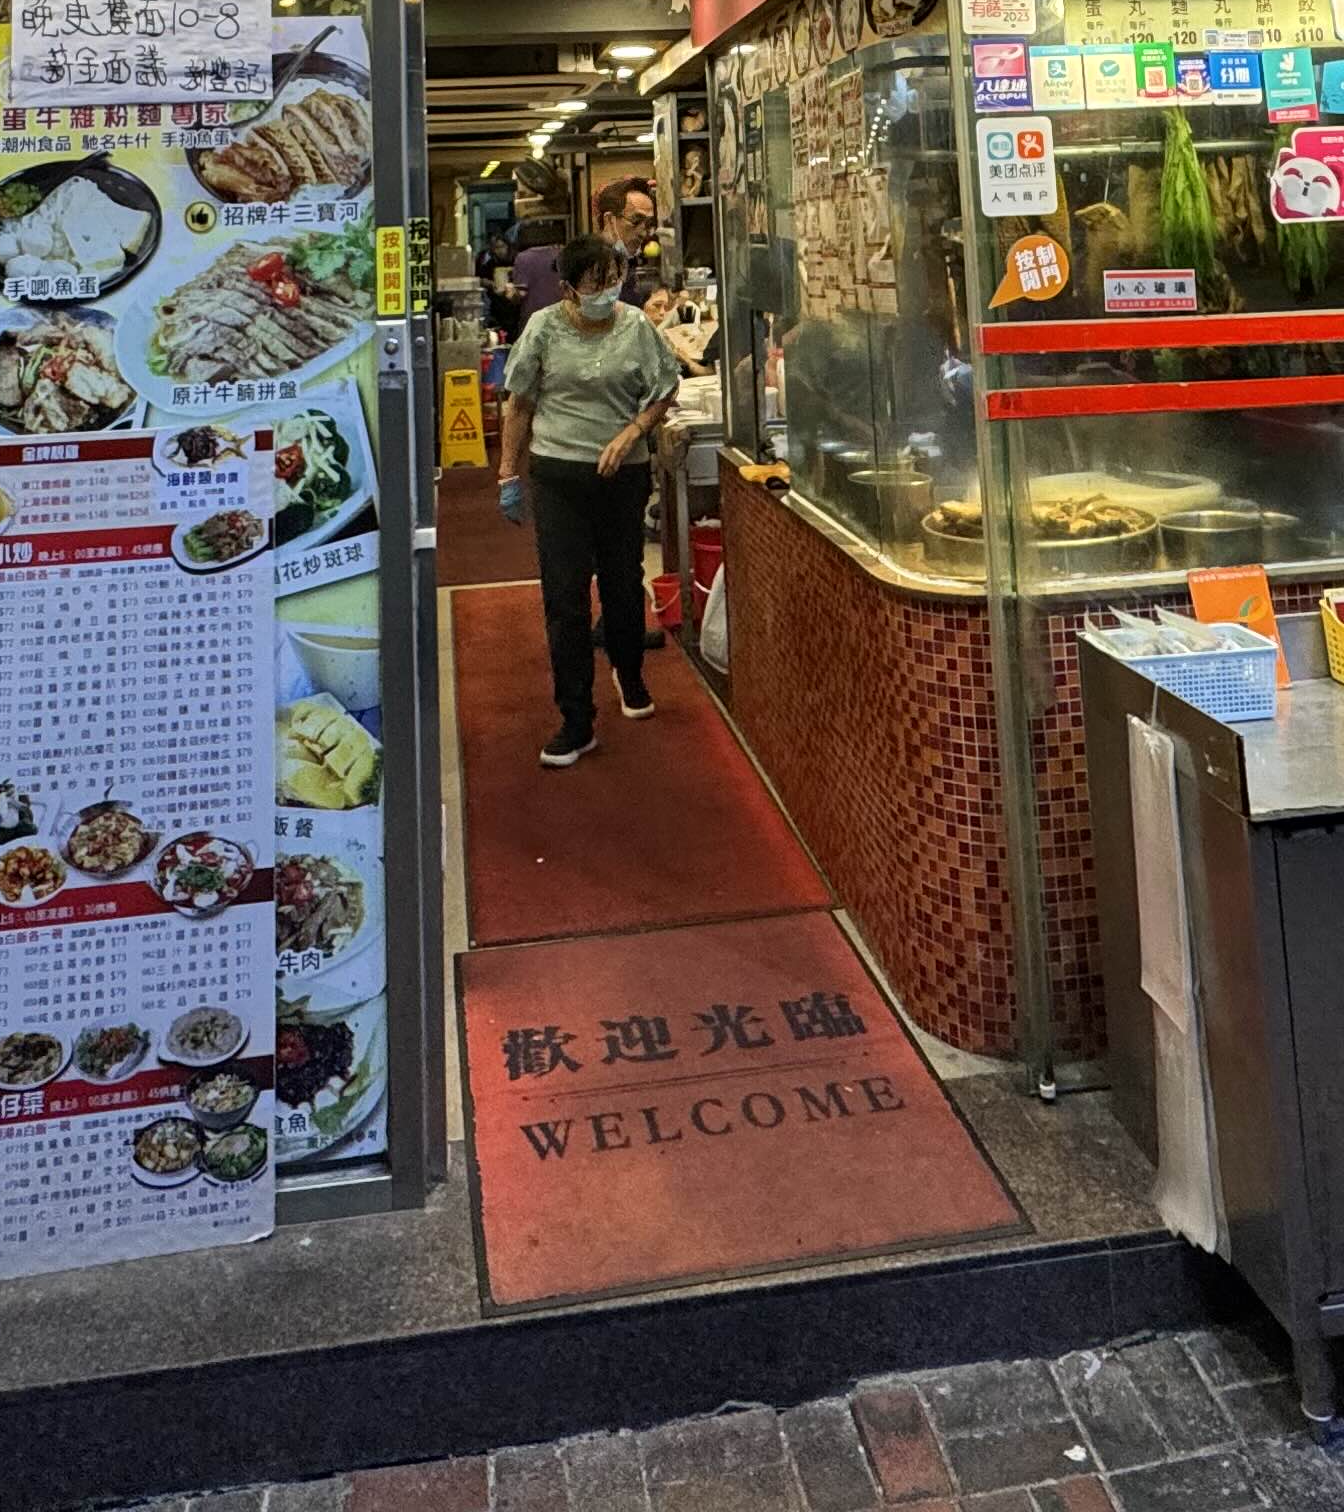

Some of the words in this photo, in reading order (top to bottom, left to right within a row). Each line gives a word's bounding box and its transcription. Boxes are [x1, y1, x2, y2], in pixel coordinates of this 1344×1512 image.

[1002, 9, 1030, 23] 2023
[501, 991, 868, 1082] 歡迎光臨
[518, 1075, 909, 1162] WELCOME
